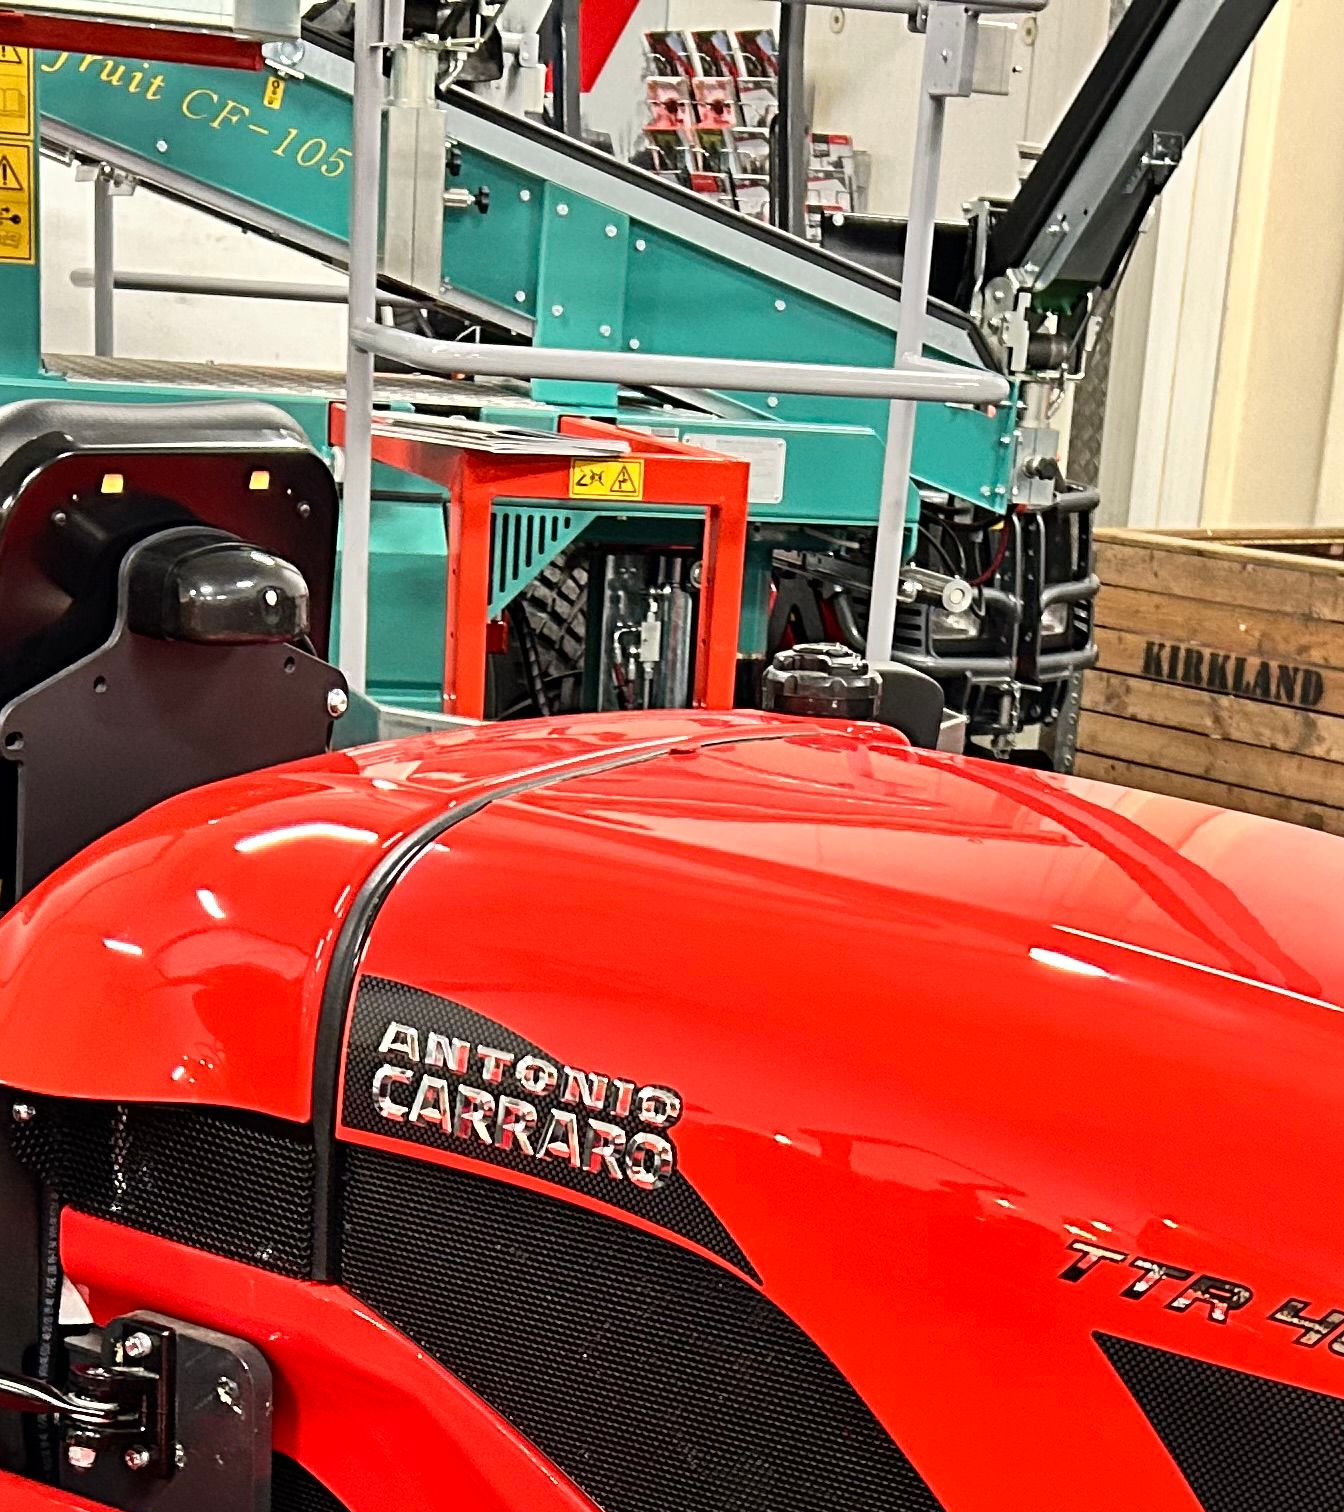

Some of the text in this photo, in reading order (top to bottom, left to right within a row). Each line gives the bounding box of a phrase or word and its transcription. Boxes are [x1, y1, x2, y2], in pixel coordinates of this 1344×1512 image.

[181, 88, 353, 178] CF-105
[1141, 640, 1324, 708] KIRKLAND
[377, 1020, 682, 1128] ANTONIO
[372, 1063, 675, 1191] CARRARO
[1058, 1238, 1254, 1326] TTR
